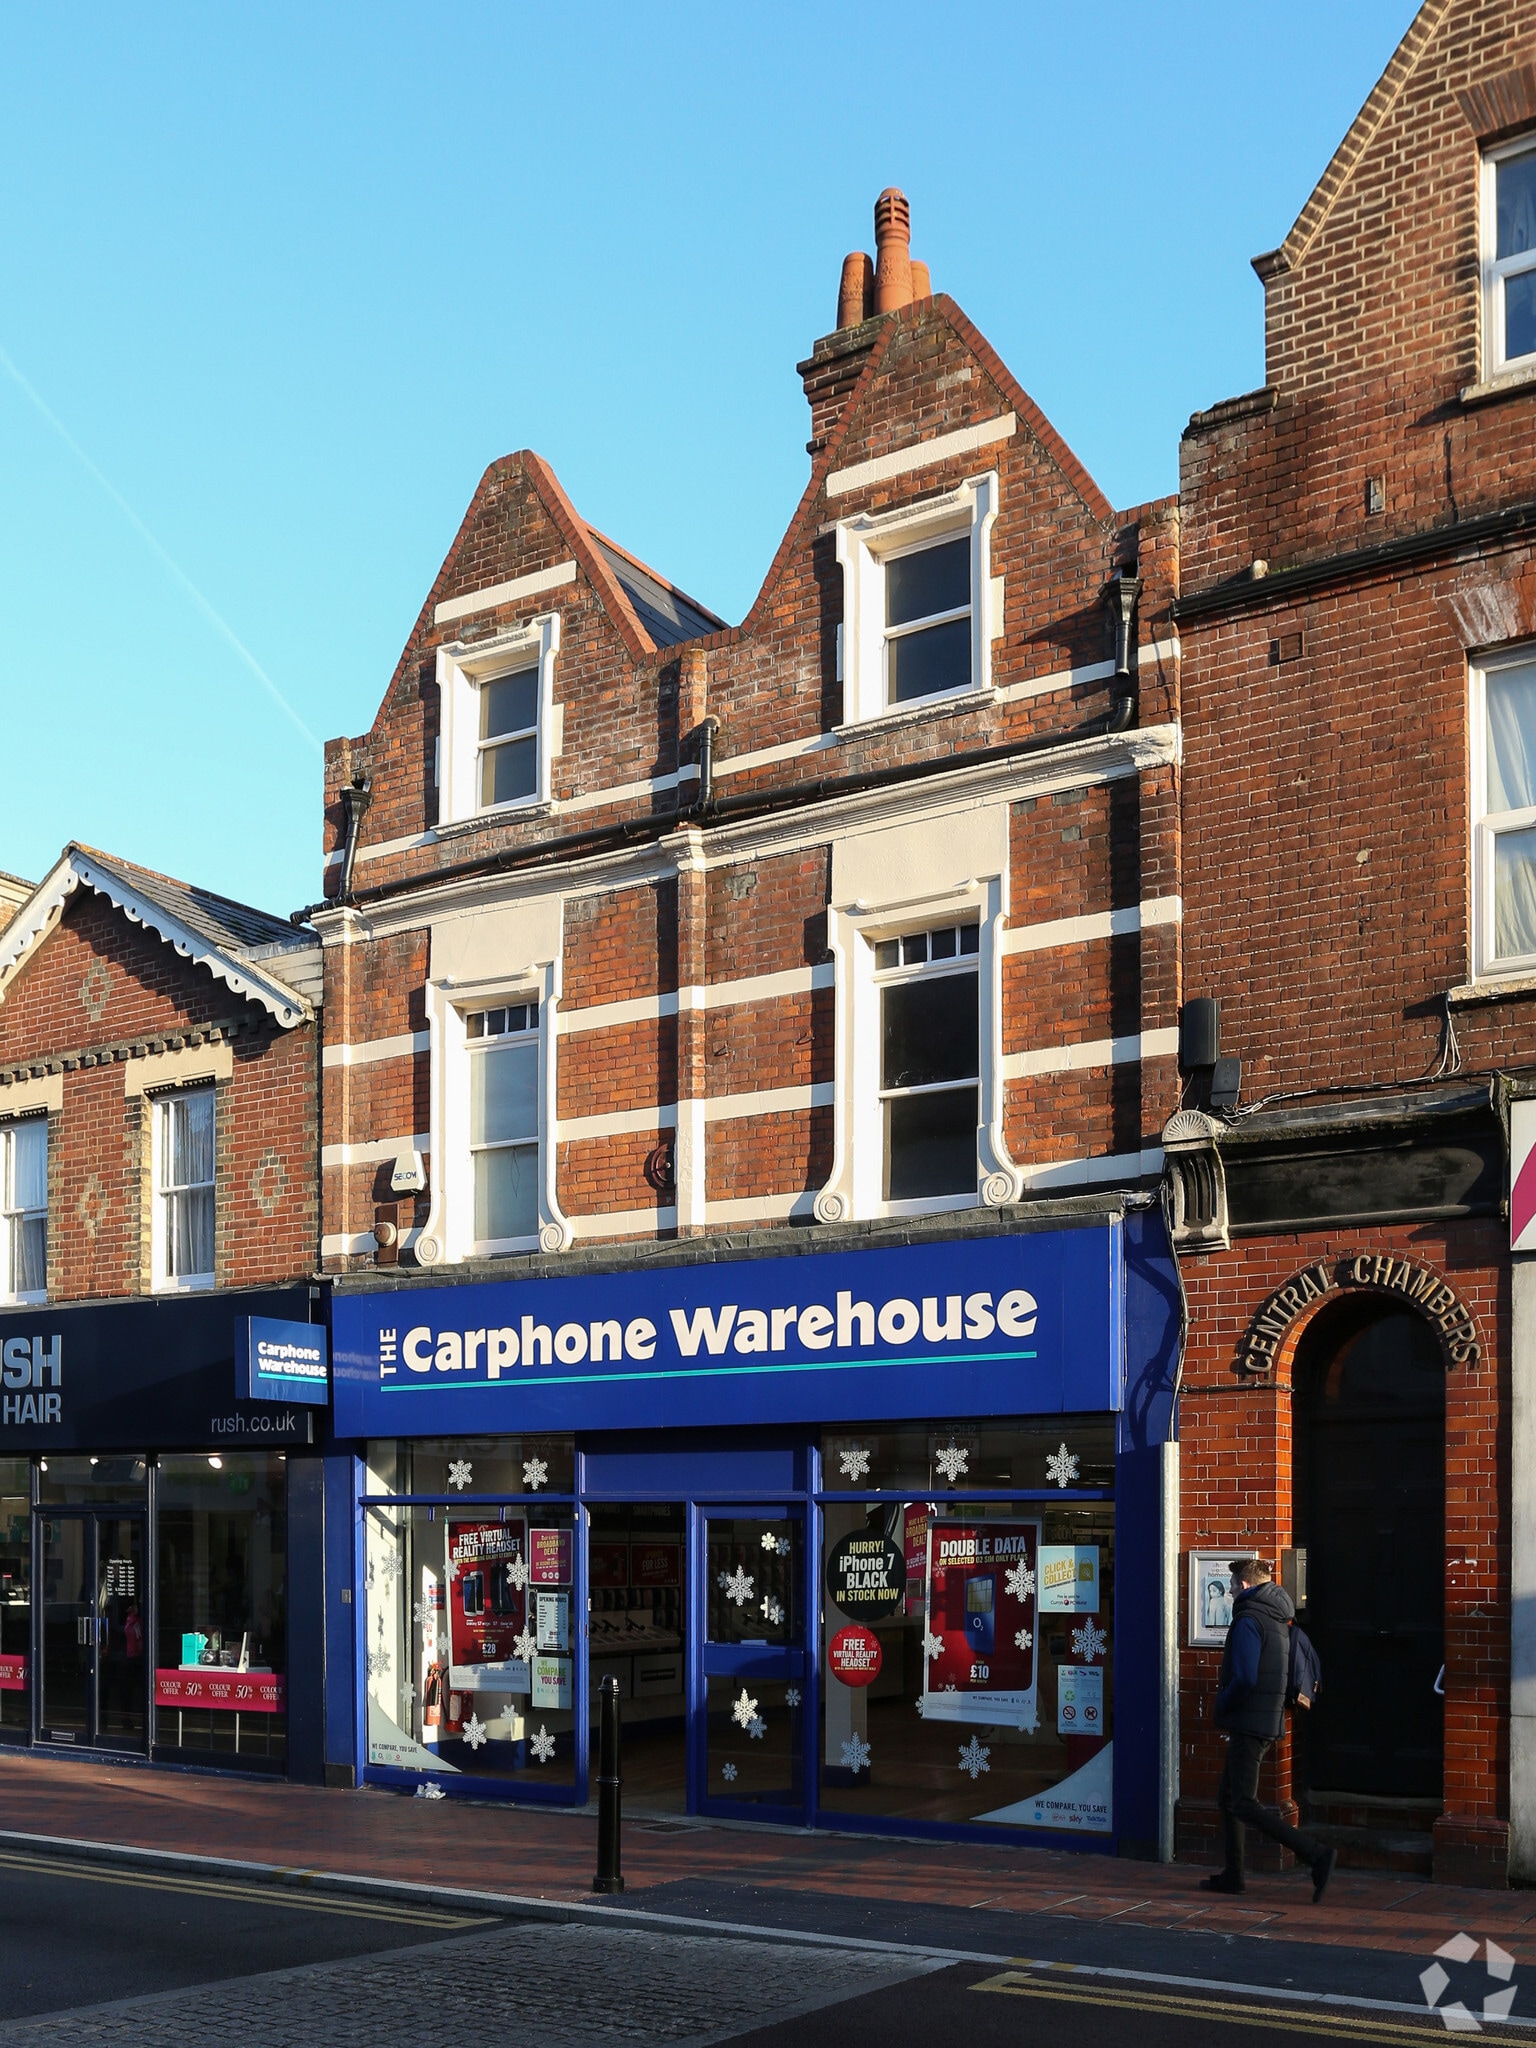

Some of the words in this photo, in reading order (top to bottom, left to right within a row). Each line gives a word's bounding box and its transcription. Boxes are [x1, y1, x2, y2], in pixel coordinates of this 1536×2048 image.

[394, 1171, 417, 1181] SECOM
[1244, 1264, 1339, 1373] CENTRAL
[1353, 1254, 1482, 1363] CHAMBERS
[402, 1315, 657, 1379] Carphone
[668, 1289, 1038, 1357] Warehouse
[257, 1341, 320, 1361] Carphone
[379, 1328, 397, 1379] THE
[258, 1357, 327, 1377] Warehouse
[3, 1392, 62, 1425] HAIR
[211, 1411, 296, 1433] rush.co.uk
[459, 1532, 479, 1546] FREE
[480, 1528, 512, 1543] VIRTUAL
[453, 1543, 485, 1559] REALITY
[486, 1539, 520, 1555] HEADSET
[849, 1540, 884, 1554] HURRY!
[940, 1539, 990, 1557] DOUBLE
[994, 1536, 1026, 1554] DATA
[840, 1556, 884, 1572] iPhone
[887, 1553, 895, 1570] 7
[939, 1558, 947, 1566] ON
[948, 1556, 975, 1565] SELECTED
[984, 1555, 994, 1563] SIM
[996, 1554, 1009, 1562] ONLY
[1045, 1560, 1066, 1575] CLICK
[1069, 1558, 1074, 1568] &
[847, 1571, 888, 1589] BLACK
[1044, 1568, 1076, 1586] COLLECT
[837, 1591, 845, 1602] IN
[848, 1589, 876, 1601] STOCK
[878, 1588, 899, 1600] NOW
[482, 1643, 496, 1654] £28
[843, 1638, 865, 1650] FREE
[833, 1650, 854, 1658] VIRTUAL
[856, 1650, 877, 1658] REALITY
[841, 1658, 870, 1667] HEADSET
[537, 1666, 566, 1676] COMPARE
[970, 1665, 990, 1679] £10
[541, 1676, 551, 1684] YOU
[553, 1677, 566, 1685] SAVE
[379, 1743, 398, 1752] COMPARE,
[1035, 1800, 1045, 1809] WE
[1046, 1801, 1077, 1812] COMPARE,
[1079, 1804, 1091, 1812] YOU
[1093, 1805, 1108, 1813] SAVE
[1069, 1814, 1083, 1824] sky
